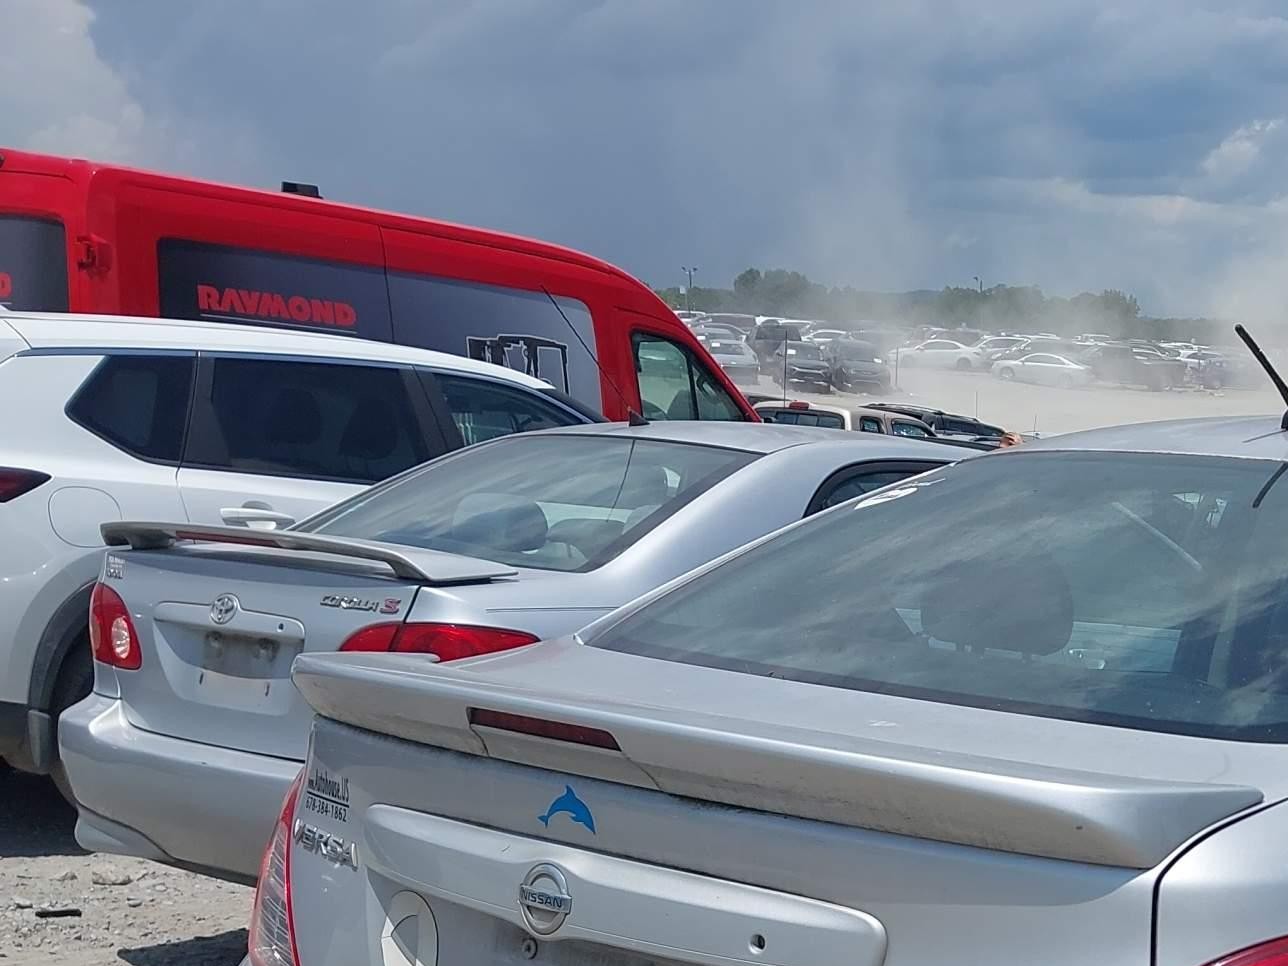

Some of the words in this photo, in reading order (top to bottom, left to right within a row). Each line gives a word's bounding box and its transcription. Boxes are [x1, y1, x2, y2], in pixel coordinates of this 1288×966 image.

[196, 284, 357, 327] RAYMOND
[380, 597, 402, 615] S
[305, 796, 347, 823] 678-384-1862
[294, 818, 359, 872] VERSA
[520, 887, 563, 908] NISSAN
